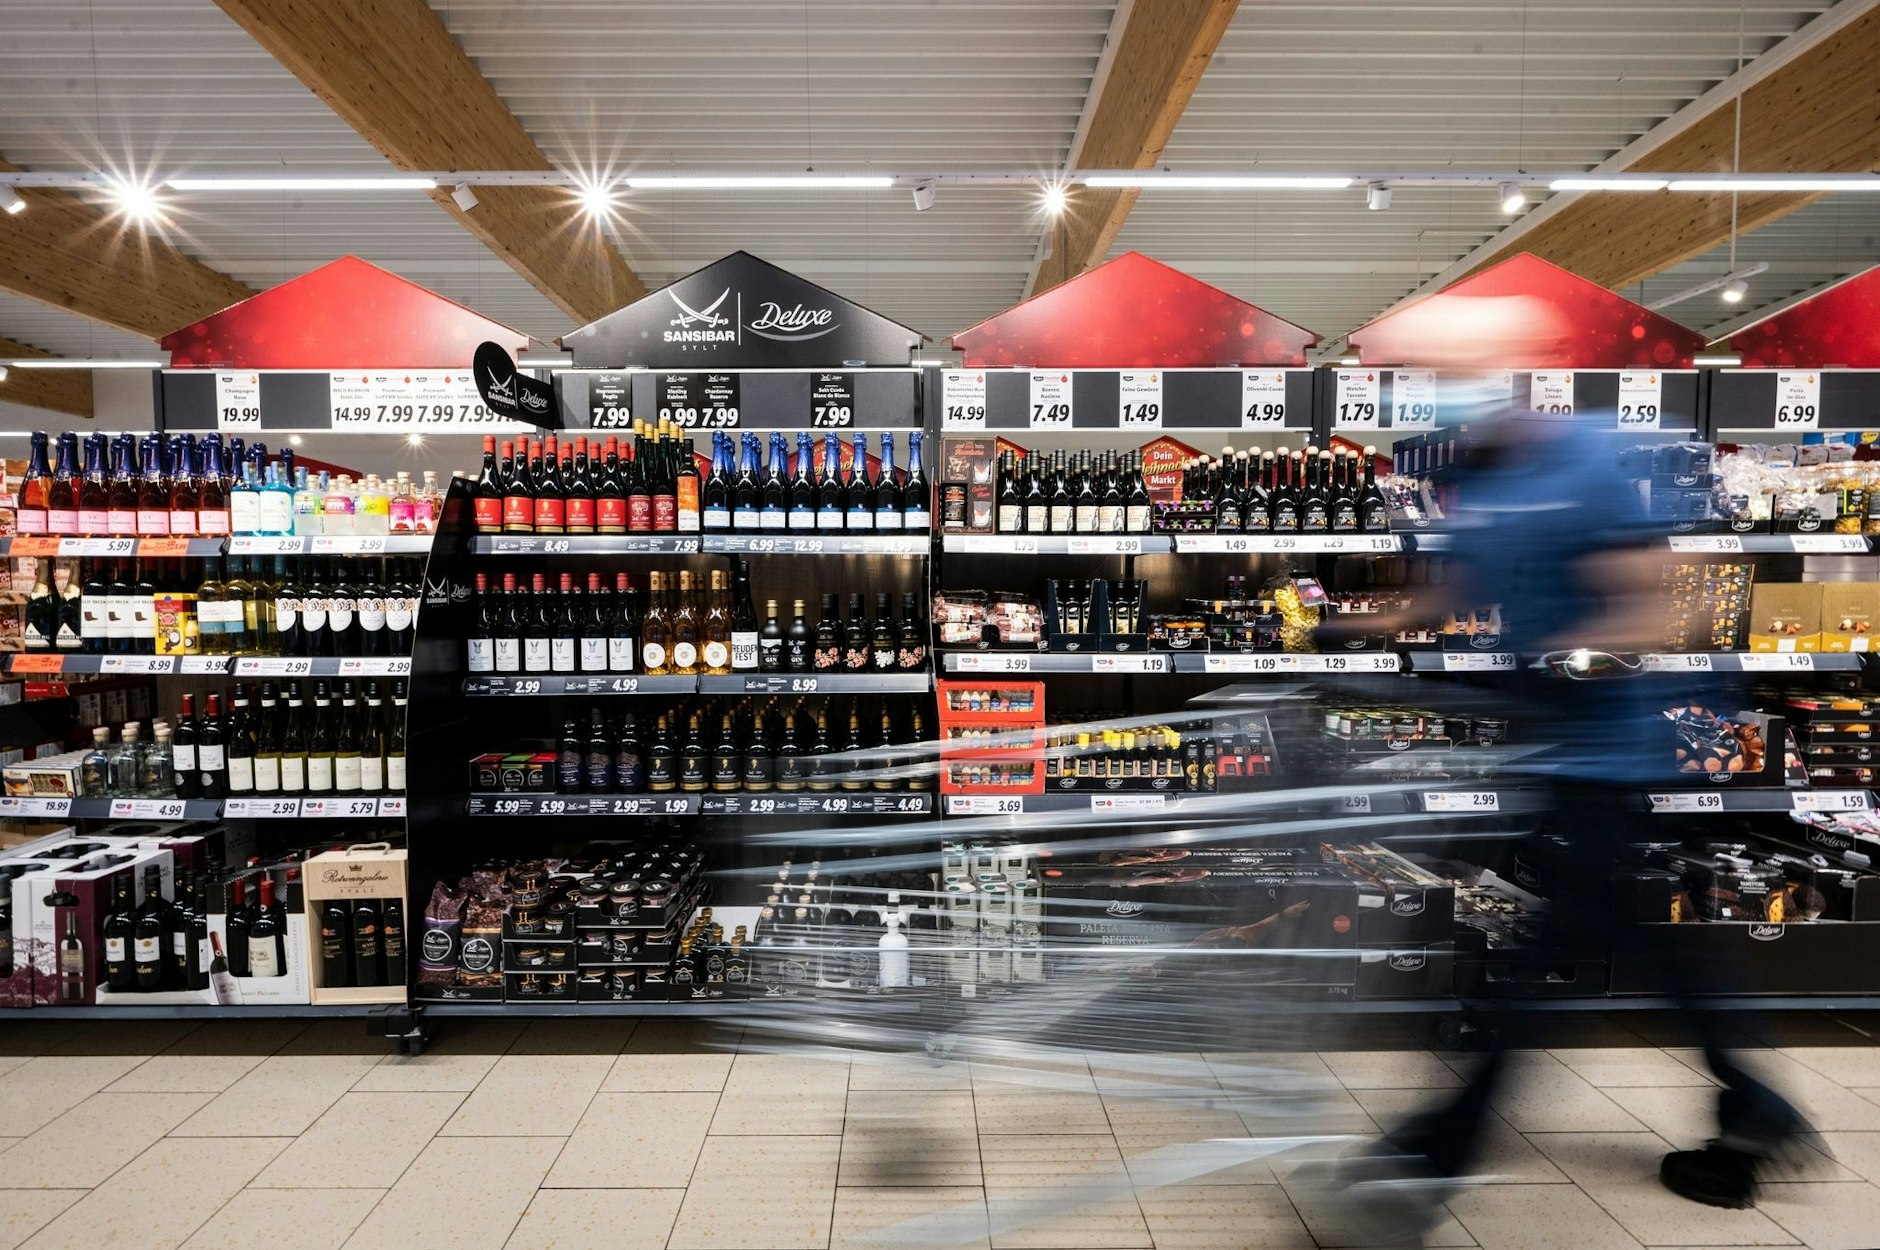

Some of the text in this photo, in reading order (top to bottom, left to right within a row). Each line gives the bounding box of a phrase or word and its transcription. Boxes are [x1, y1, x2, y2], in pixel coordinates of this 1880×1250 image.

[752, 302, 832, 332] Deluxe
[663, 330, 736, 343] SANSIBAR
[682, 344, 718, 352] SYLT
[519, 387, 549, 409] Deluxe
[704, 388, 734, 396] Chardonnay
[487, 391, 516, 407] SANSIBAR
[222, 407, 260, 422] 19.99
[333, 407, 371, 421] 14.99
[376, 405, 413, 423] 7.99
[417, 405, 454, 423] 7.99
[459, 405, 495, 423] 7.99
[947, 406, 985, 421] 14.99
[1032, 404, 1070, 422] 7.49
[1123, 403, 1159, 422] 1.49
[1246, 403, 1284, 421] 4.99
[1340, 403, 1375, 422] 1.79
[1398, 403, 1434, 422] 1.99
[1536, 404, 1572, 415] 199
[1621, 404, 1657, 422] 2.59
[1778, 404, 1815, 422] 6.99
[593, 407, 630, 427] 7.99
[702, 407, 739, 427] 7.99
[813, 406, 851, 426] 7.99
[1153, 451, 1173, 460] Dein
[1142, 456, 1188, 475] eihnach
[1151, 475, 1176, 484] Markt
[107, 540, 131, 551] 5.99
[278, 540, 301, 551] 2.99
[359, 539, 382, 550] 3.99
[544, 540, 569, 552] 8.49
[674, 540, 698, 552] 7.99
[749, 540, 774, 552] 6.99
[793, 540, 823, 552] 12.99
[1116, 541, 1138, 551] 2.99
[1225, 539, 1247, 551] 1.49
[1273, 538, 1296, 548] 2.99
[1370, 538, 1392, 549] 1.19
[1716, 538, 1739, 549] 3.99
[1840, 538, 1862, 549] 3.99
[450, 584, 472, 598] Deluxe
[1473, 635, 1497, 645] Deluxe
[732, 644, 758, 653] REUDEN
[735, 652, 752, 661] FEST
[1491, 655, 1513, 665] 3.99
[1686, 656, 1708, 667] 1.99
[1788, 655, 1810, 666] 1.49
[148, 660, 171, 671] 8.99
[204, 661, 228, 671] 9.99
[285, 662, 308, 673] 2.99
[387, 662, 410, 673] 2.99
[1005, 659, 1028, 670] 3.99
[1142, 659, 1163, 670] 1.19
[1254, 658, 1276, 669] 1.09
[1324, 658, 1346, 669] 1.29
[1373, 658, 1395, 669] 3.99
[514, 680, 540, 693] 2.99
[612, 679, 638, 692] 4.99
[792, 678, 817, 691] 8.99
[45, 800, 68, 811] 19.99
[750, 799, 775, 812] 2.99
[822, 799, 848, 811] 4.99
[898, 798, 923, 811] 4.49
[1345, 795, 1368, 808] 2.99
[1473, 794, 1495, 805] 2.99
[1698, 795, 1720, 806] 6.99
[1841, 796, 1863, 807] 1.59
[159, 805, 182, 816] 4.99
[272, 803, 296, 814] 2.99
[349, 803, 373, 814] 5.79
[494, 800, 520, 813] 5.99
[540, 800, 565, 813] 5.99
[613, 800, 639, 813] 2.99
[665, 800, 688, 812] 1.99
[998, 800, 1020, 812] 3.69
[1812, 832, 1851, 848] Deluxe
[1106, 900, 1143, 914] Deluxe
[1394, 901, 1422, 912] Deluxe
[1080, 923, 1118, 934] PALETA
[1754, 924, 1780, 936] Deluxe
[1102, 935, 1150, 945] RESERVA
[1394, 956, 1422, 966] Deluxe
